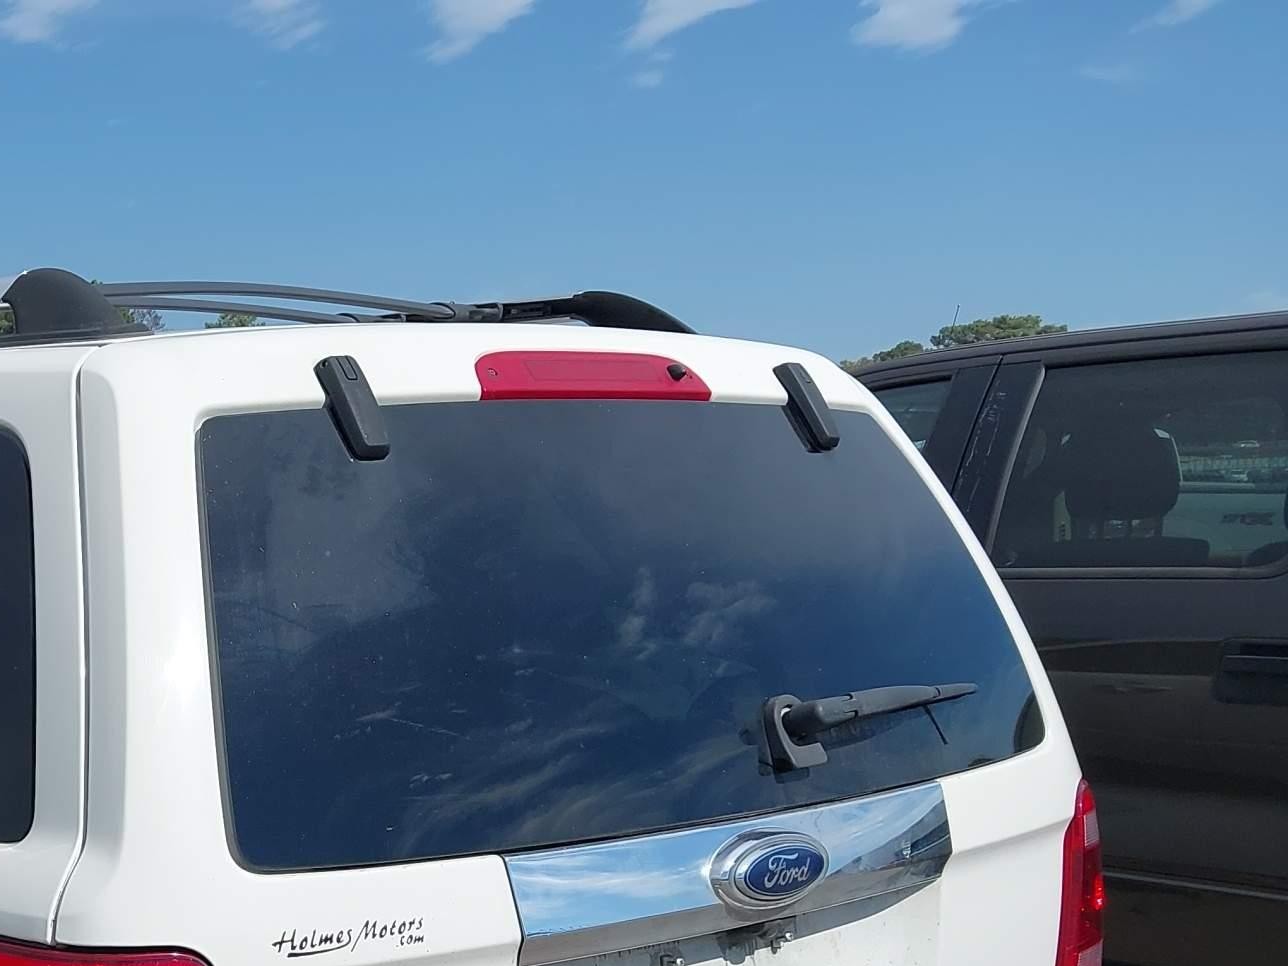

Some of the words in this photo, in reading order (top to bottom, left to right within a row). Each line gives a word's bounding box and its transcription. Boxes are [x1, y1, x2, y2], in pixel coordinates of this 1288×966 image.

[764, 852, 812, 889] Ford
[271, 928, 353, 957] Holmes
[351, 917, 424, 952] Motors
